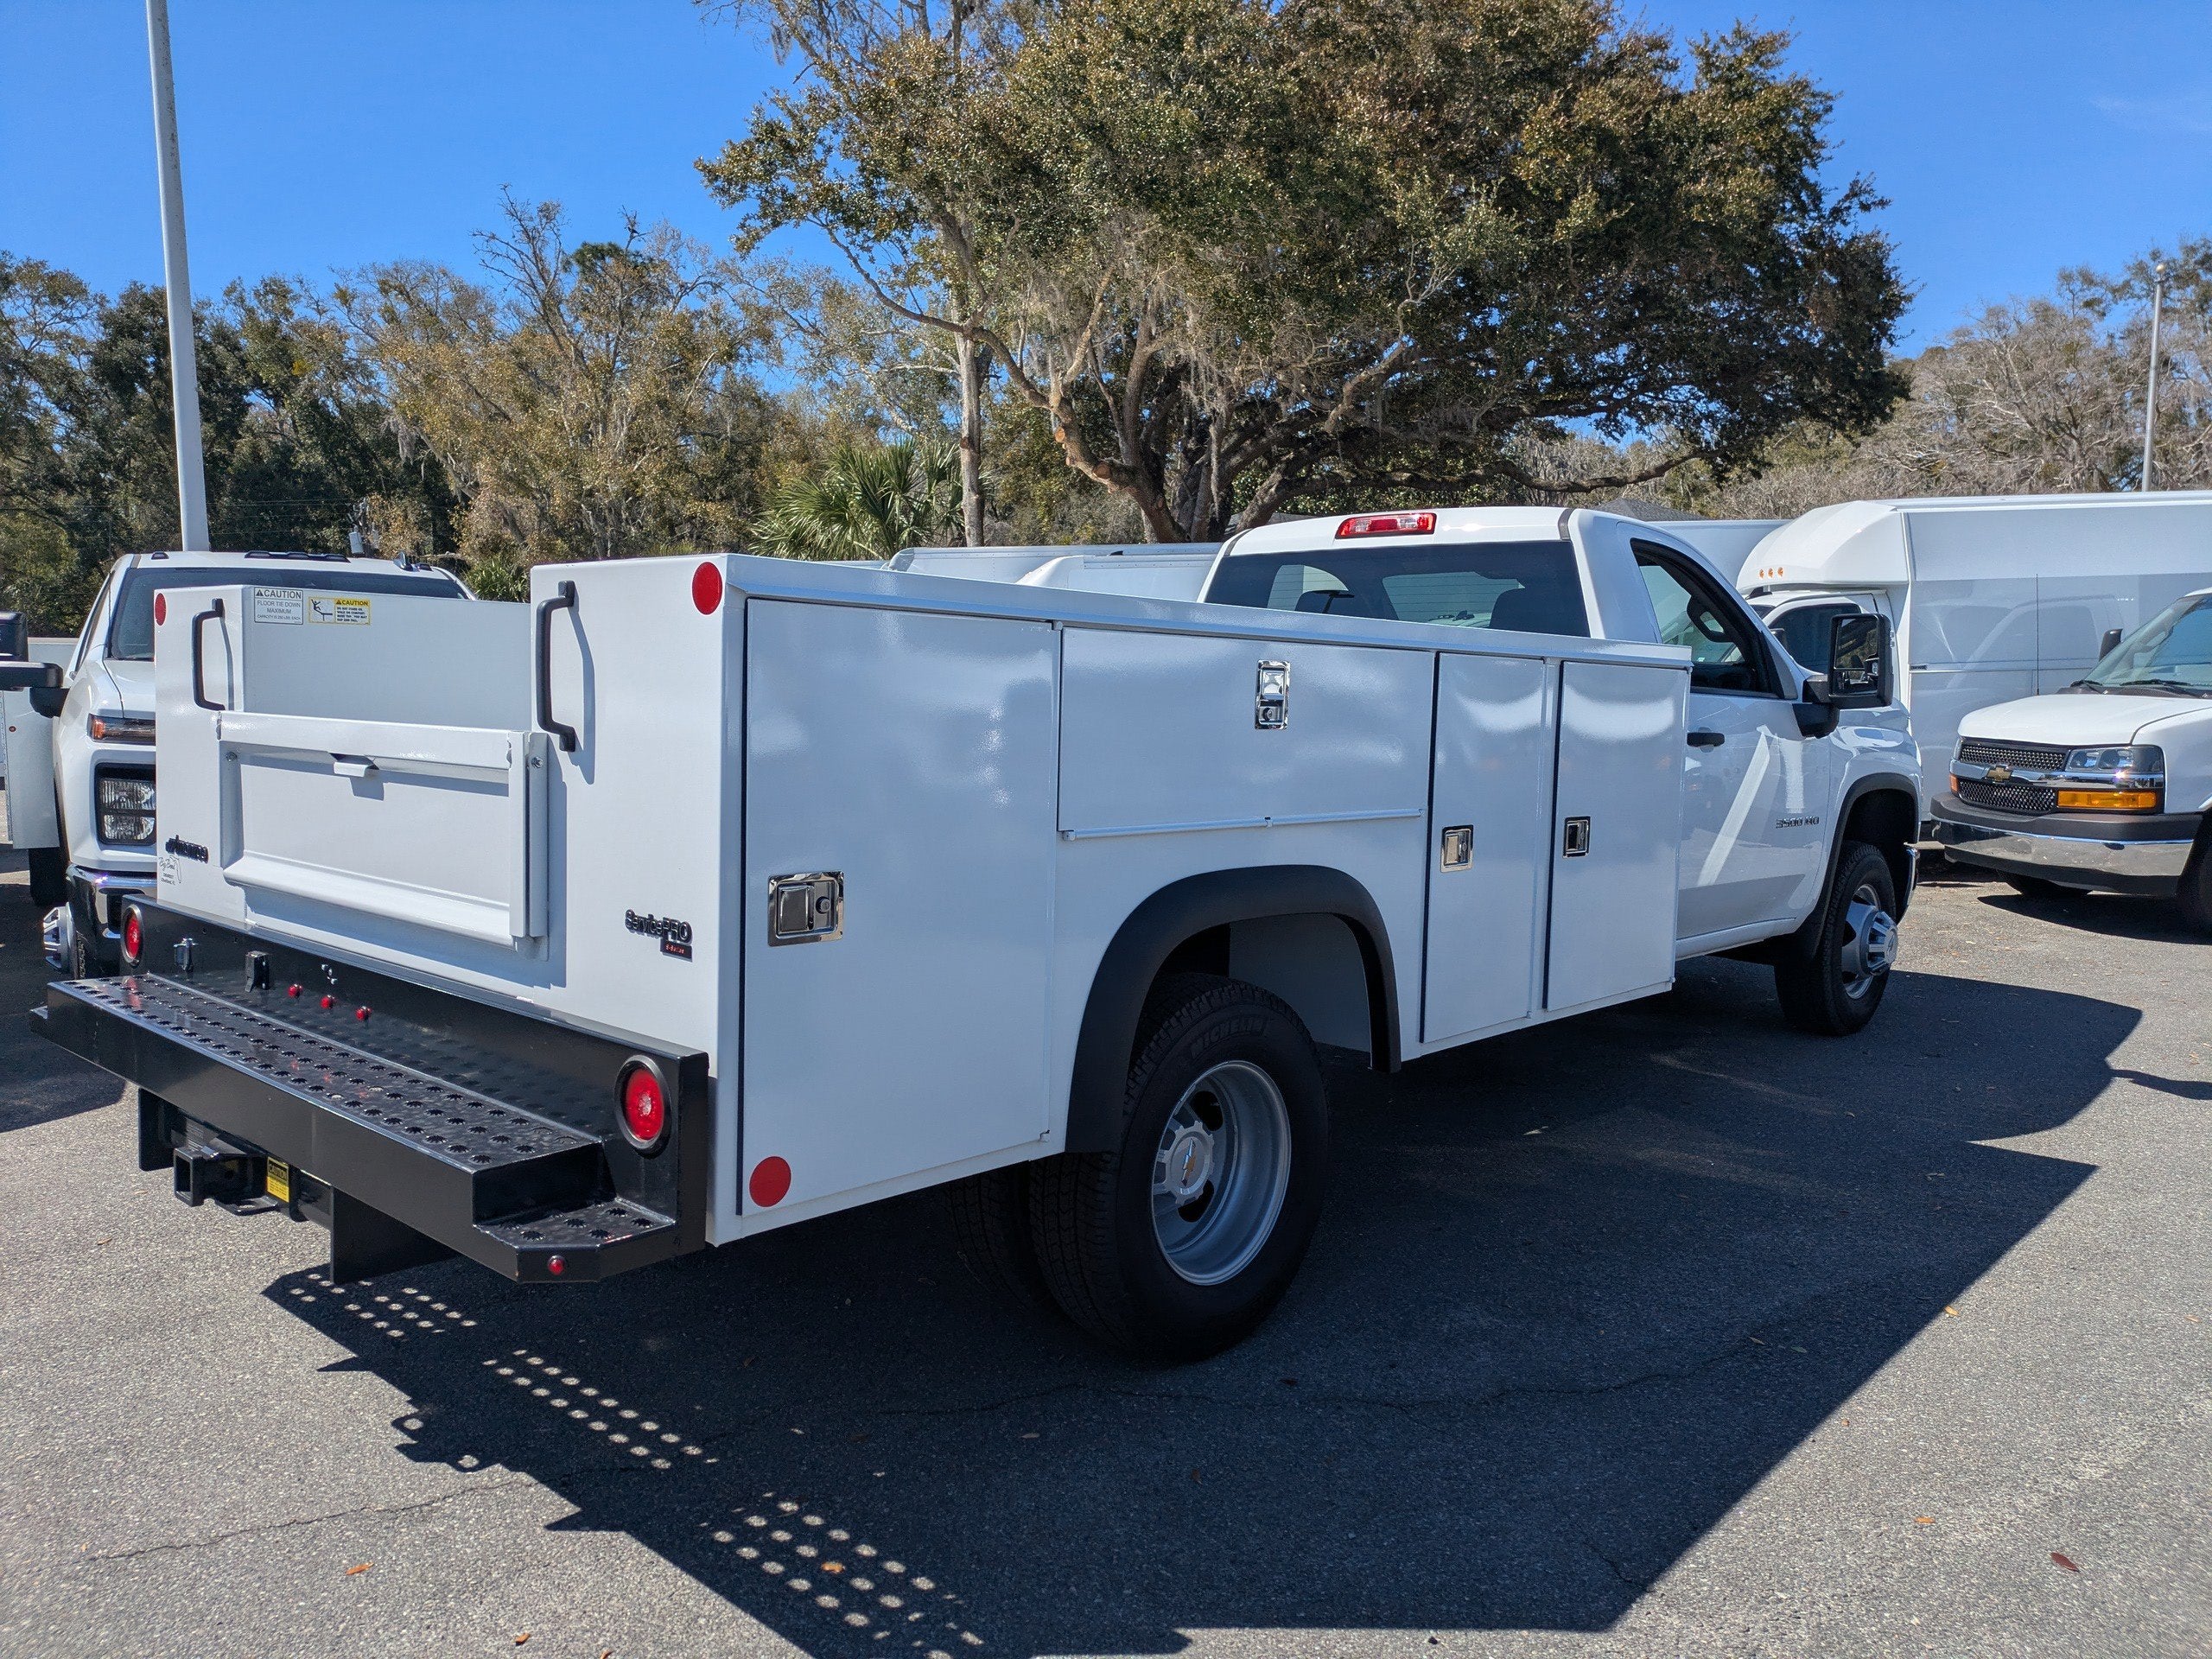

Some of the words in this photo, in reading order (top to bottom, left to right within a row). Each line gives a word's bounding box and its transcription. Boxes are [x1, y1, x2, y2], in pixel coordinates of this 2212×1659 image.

[264, 589, 302, 599] CAUTION
[1776, 817, 1802, 829] 3500
[1805, 817, 1820, 826] HD
[625, 909, 693, 944] ServicePRO
